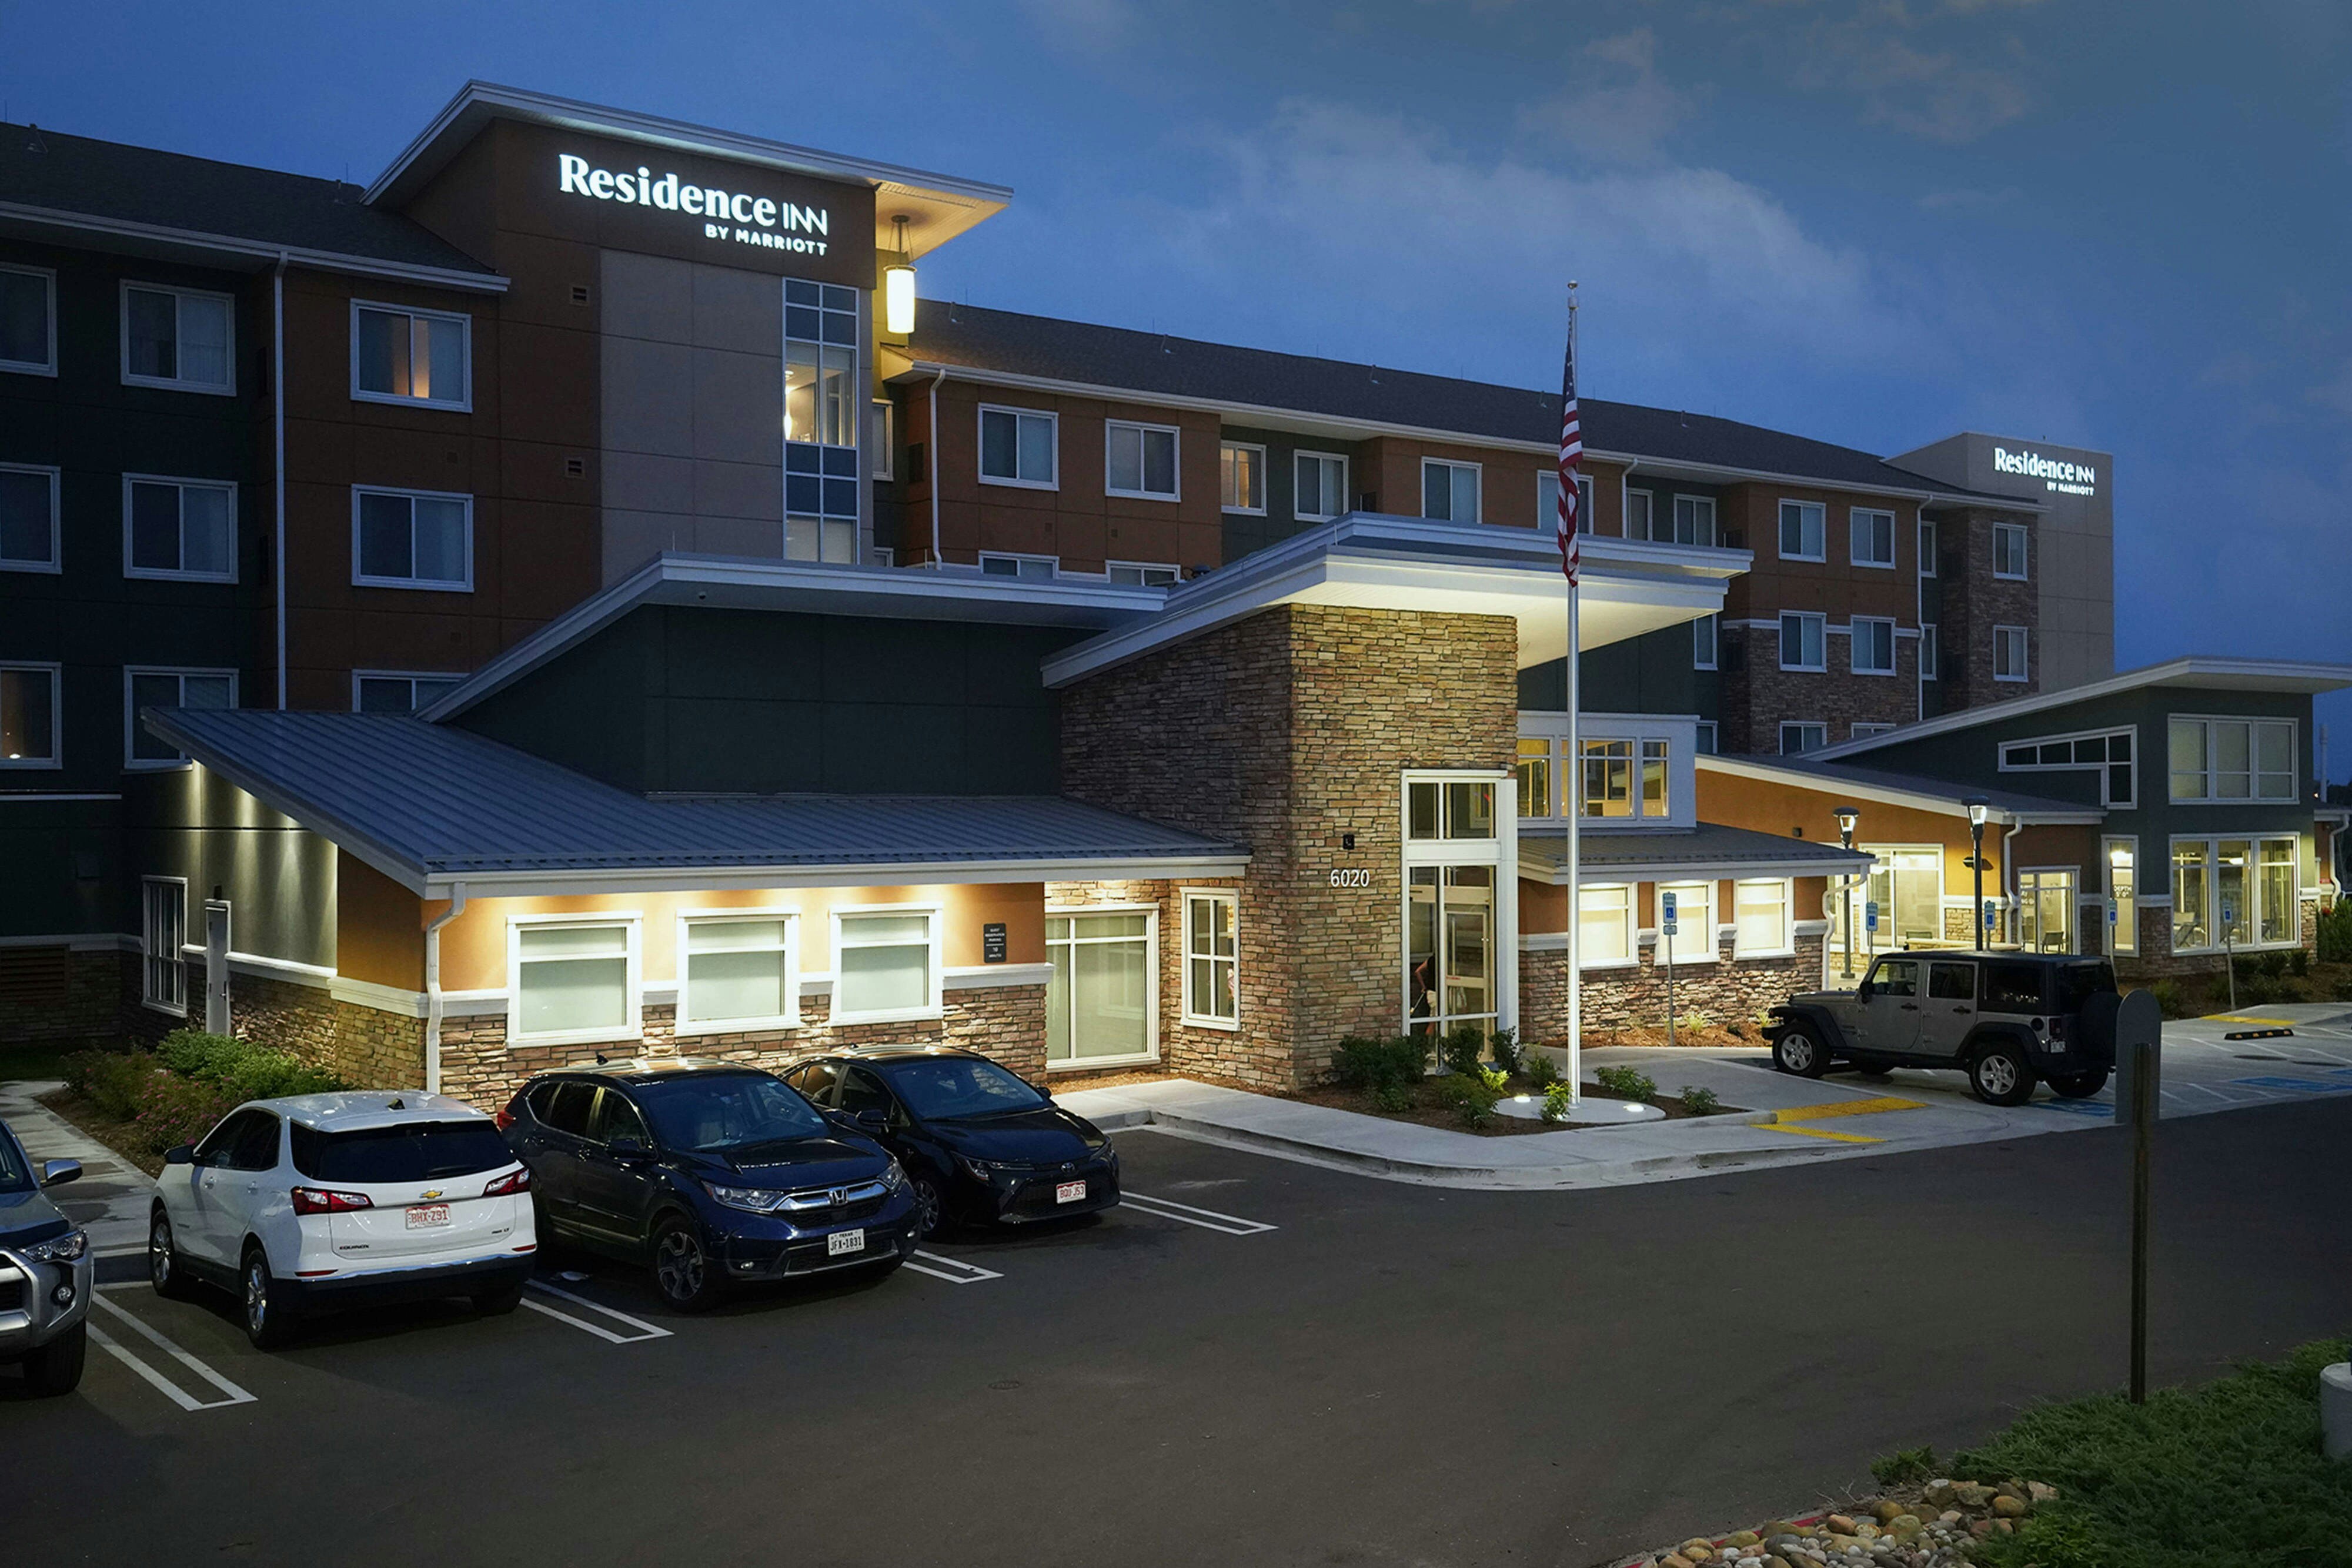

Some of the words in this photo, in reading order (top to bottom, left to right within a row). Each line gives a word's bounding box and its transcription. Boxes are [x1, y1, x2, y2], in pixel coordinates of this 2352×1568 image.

[559, 153, 776, 226] Residence
[783, 202, 828, 235] INN
[705, 223, 729, 240] BY
[735, 228, 828, 256] MARRIOTT
[1994, 447, 2074, 482] Residence
[2076, 464, 2094, 484] INN
[2047, 481, 2056, 492] BY
[2057, 483, 2094, 496] MARRIOTT
[1330, 869, 1369, 887] 6020
